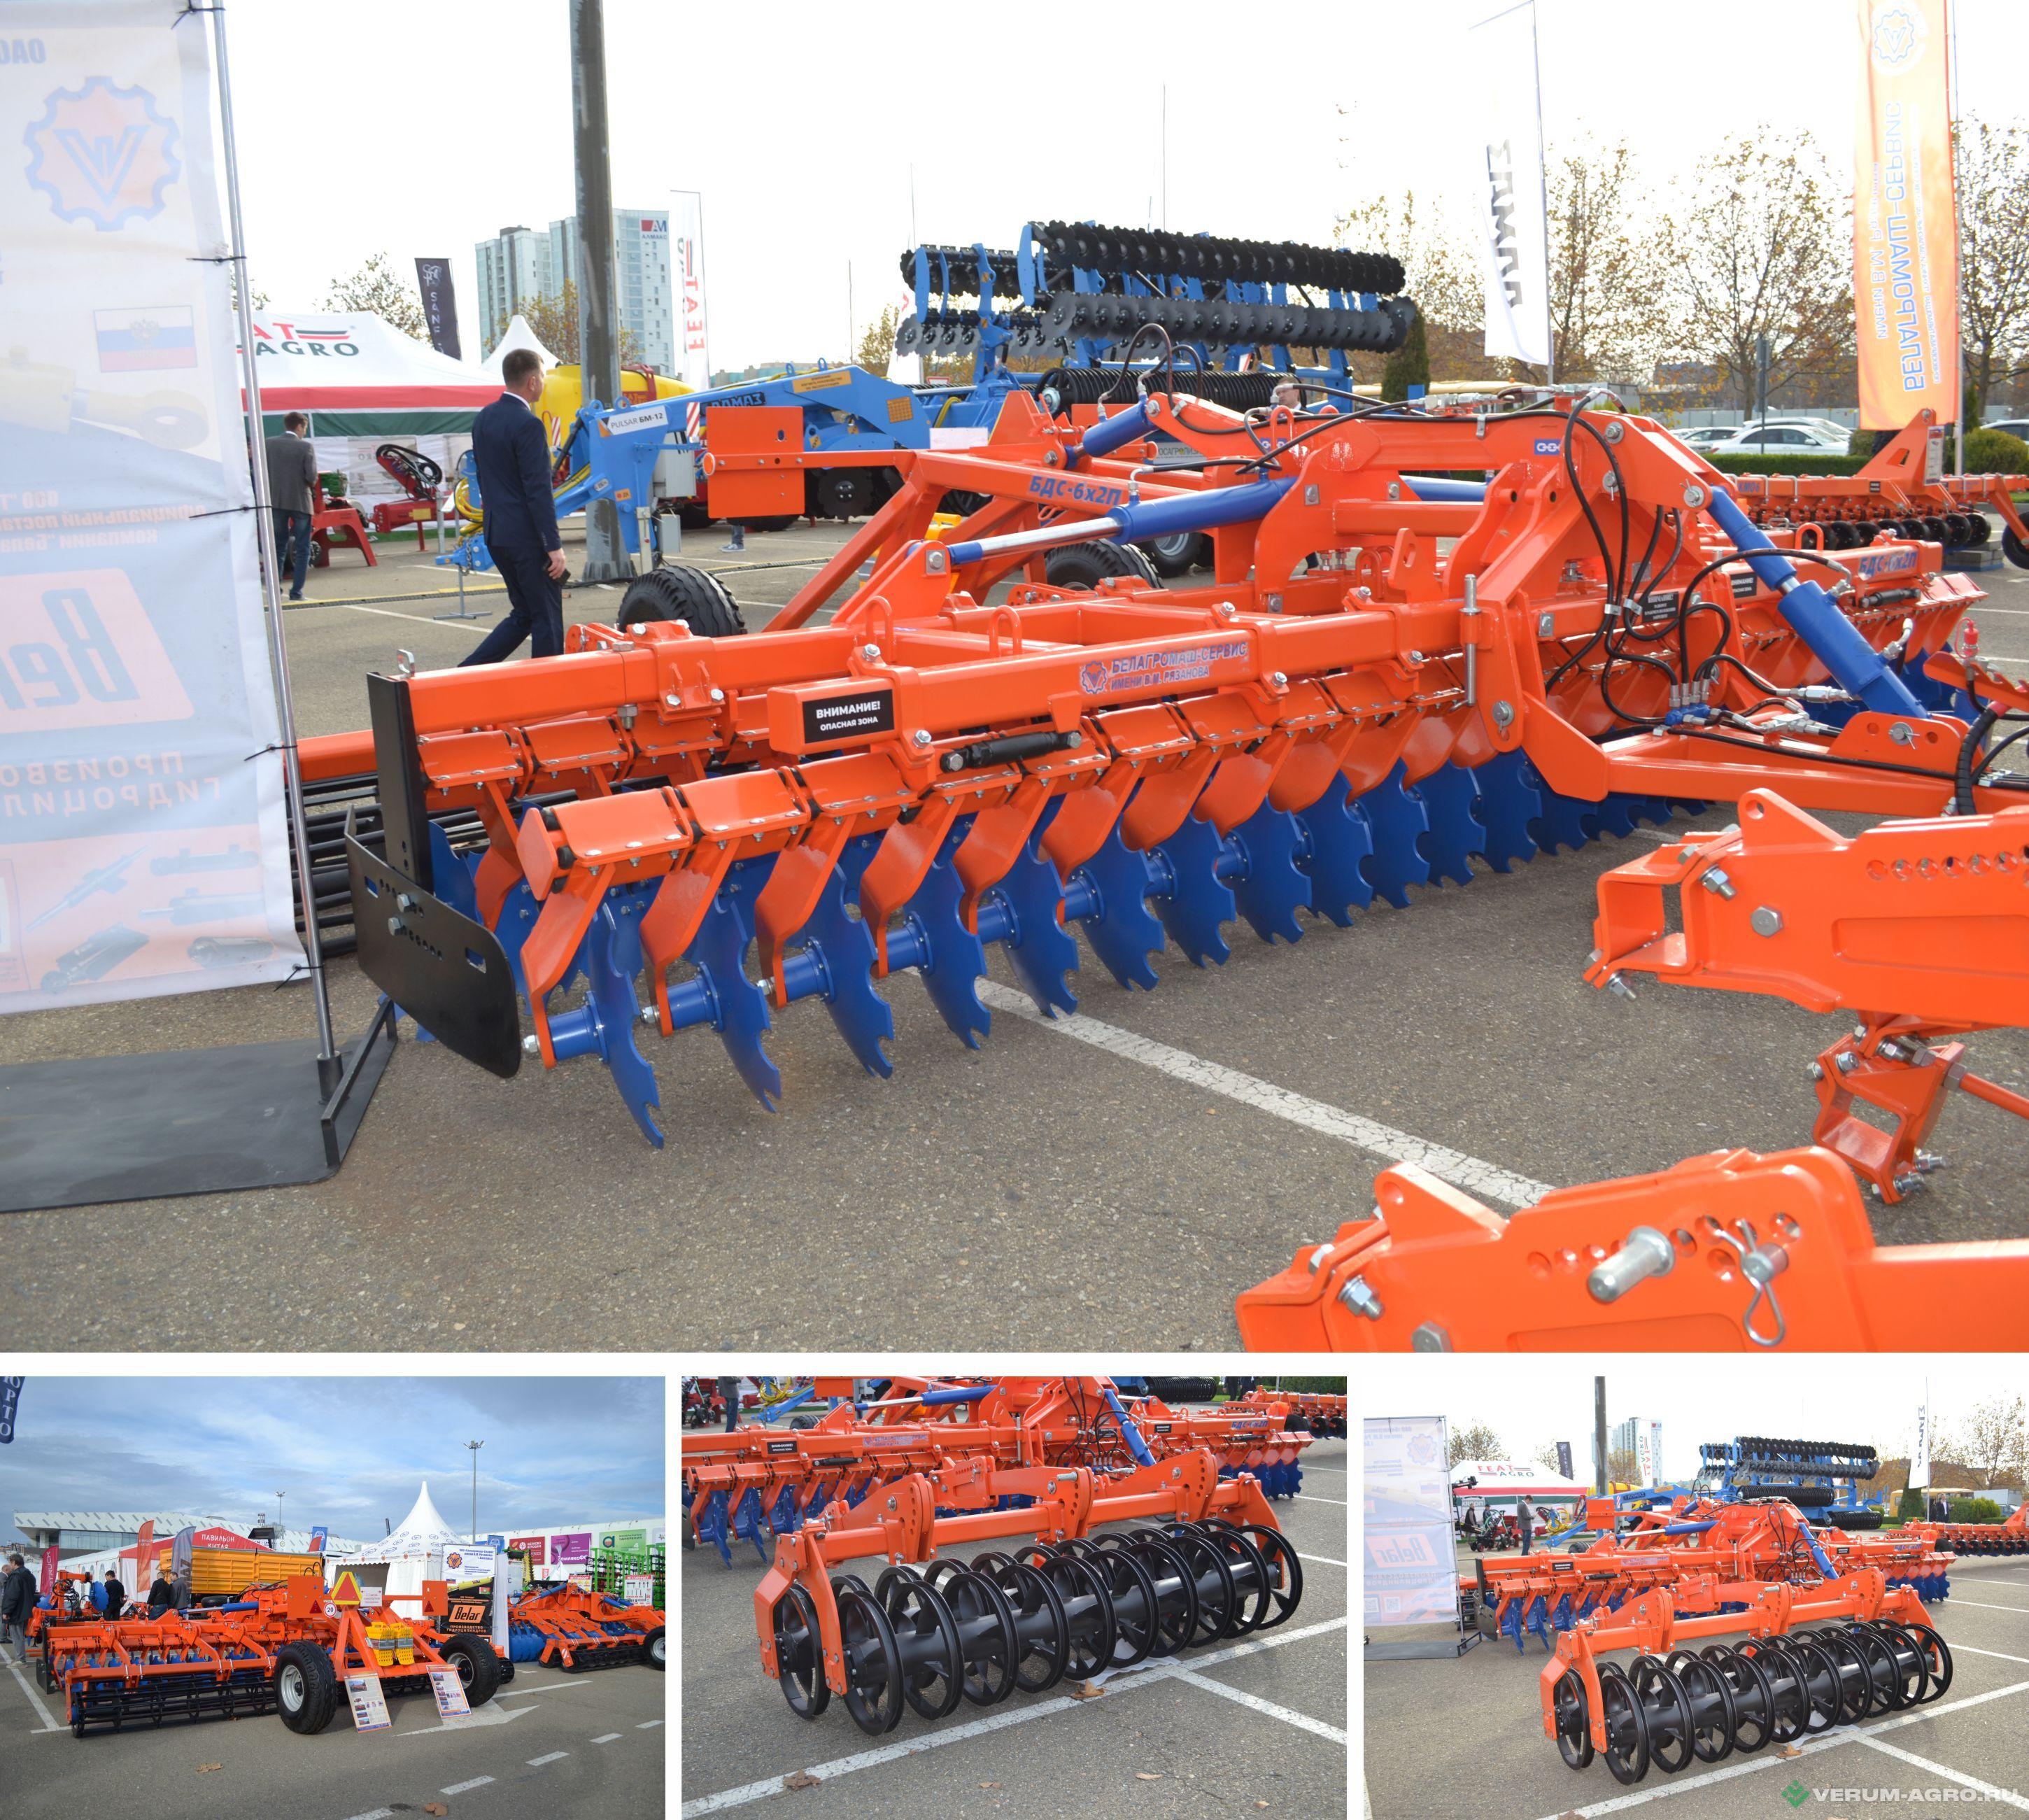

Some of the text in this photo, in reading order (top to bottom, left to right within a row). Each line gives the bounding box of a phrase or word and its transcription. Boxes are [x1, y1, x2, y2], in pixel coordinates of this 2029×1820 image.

[256, 341, 359, 356] AGRO
[611, 413, 663, 429] PULSAR БМ-12
[1112, 641, 1247, 674] БЕЛАГРОМАШ-СЕРВИС
[1110, 676, 1143, 690] ИМЕНИ
[1164, 666, 1210, 683] РЯЗАНОВА
[816, 700, 881, 719] ВНИМАНИЕ!
[820, 716, 879, 731] ОПАСНАЯ ЗОНА
[454, 1607, 481, 1621] Belar
